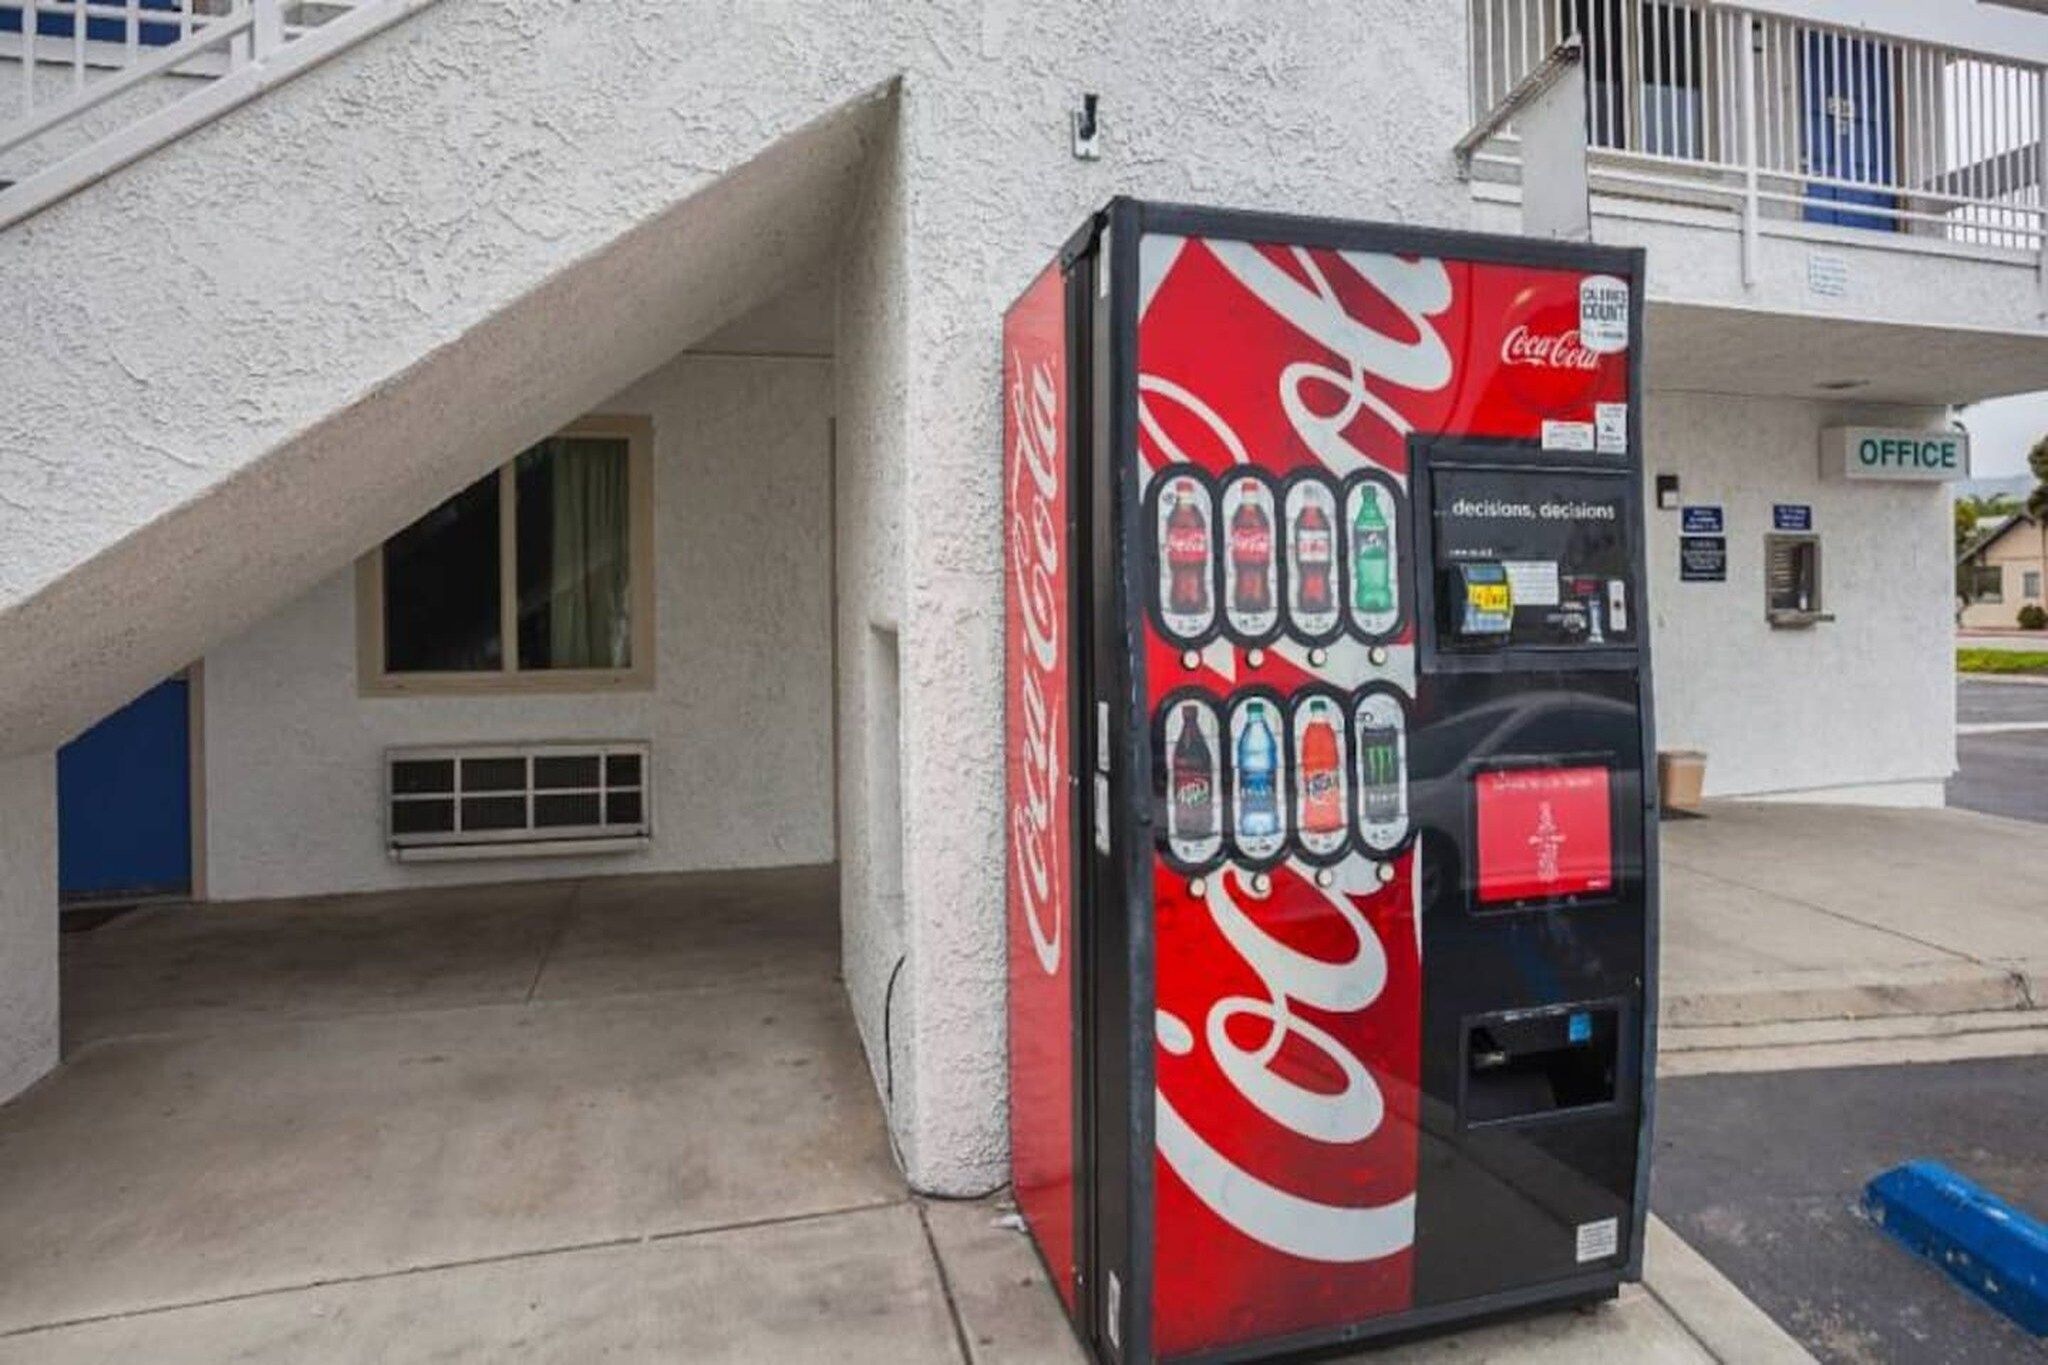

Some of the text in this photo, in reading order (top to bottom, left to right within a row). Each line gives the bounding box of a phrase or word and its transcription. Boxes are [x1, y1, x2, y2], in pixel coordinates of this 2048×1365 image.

[1860, 439, 1956, 468] OFFICE
[1452, 499, 1615, 520] decisions, decisions
[1011, 347, 1062, 975] Coca-Cola
